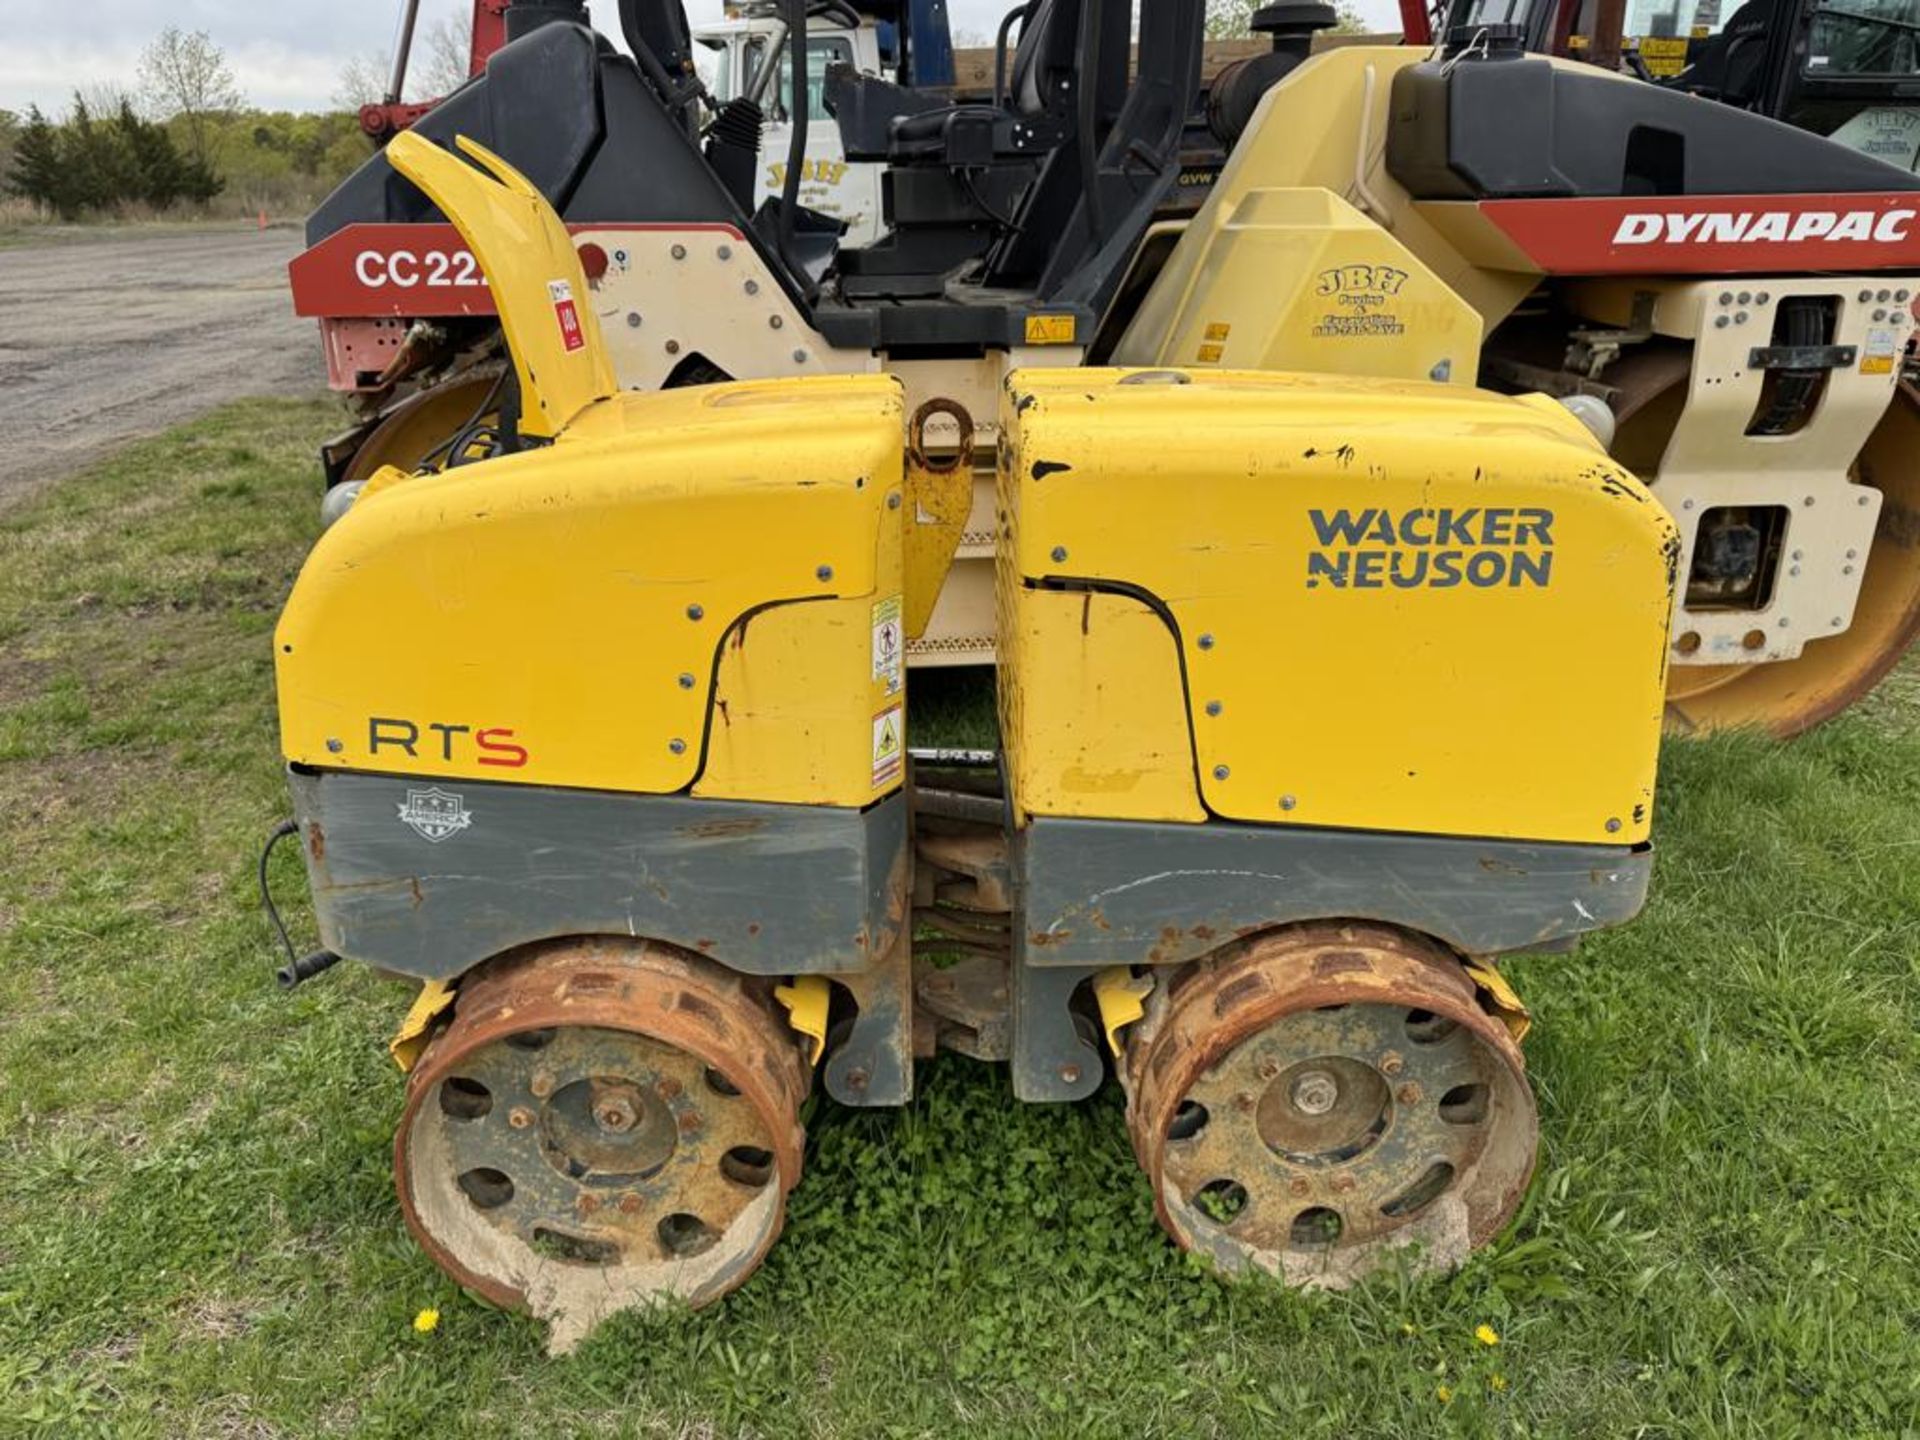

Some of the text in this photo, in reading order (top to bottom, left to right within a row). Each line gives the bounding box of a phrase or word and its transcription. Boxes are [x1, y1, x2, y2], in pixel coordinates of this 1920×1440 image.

[1612, 209, 1917, 245] DYNAPAC
[424, 250, 489, 287] 22
[1316, 264, 1409, 296] JBH
[1307, 507, 1555, 547] WACKER
[1306, 550, 1554, 589] NEUSON
[369, 716, 529, 769] RTS
[404, 809, 465, 826] AMERICA
